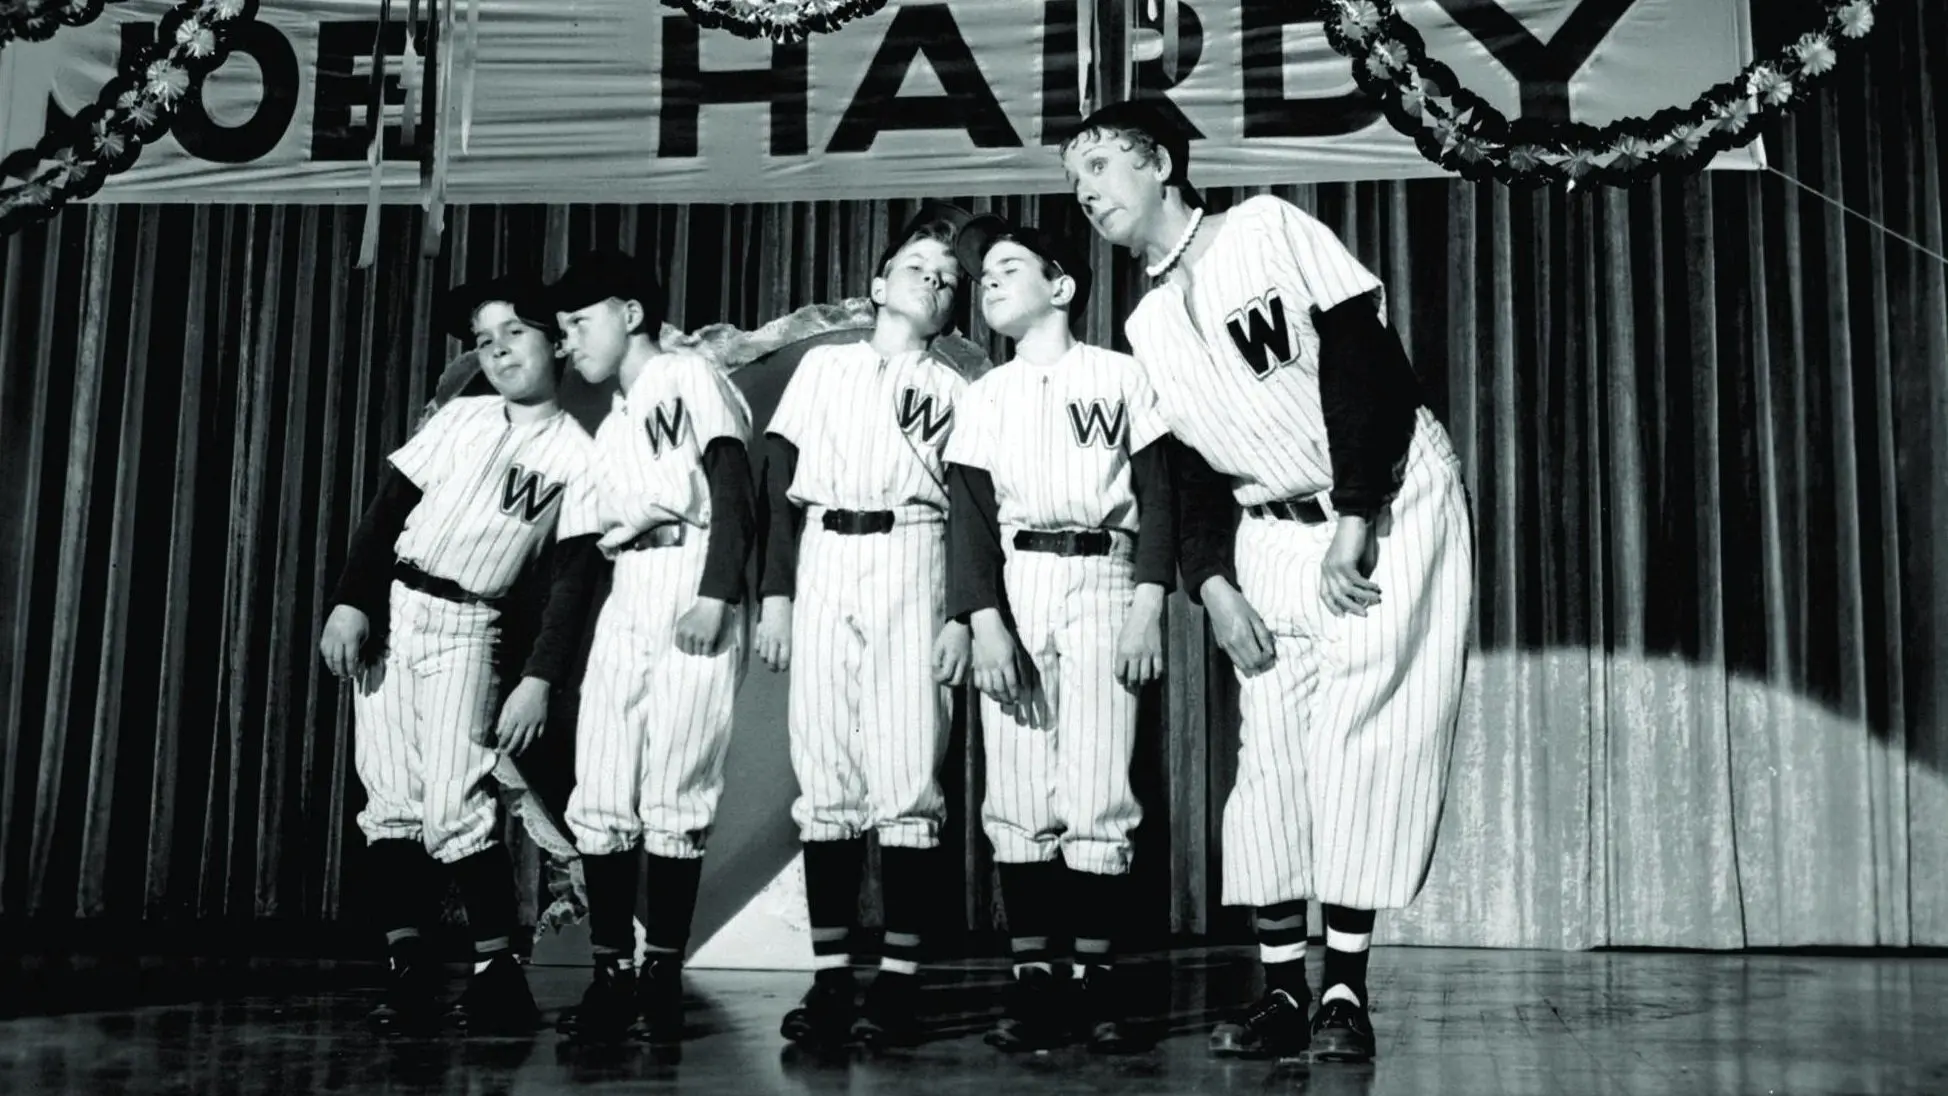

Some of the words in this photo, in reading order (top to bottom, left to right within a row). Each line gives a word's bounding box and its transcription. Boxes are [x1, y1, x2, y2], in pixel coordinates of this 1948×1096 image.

[657, 0, 1636, 158] HARDY
[1226, 287, 1299, 380] W
[644, 396, 686, 459] W
[900, 385, 954, 443] W
[1067, 397, 1129, 449] W
[500, 463, 565, 524] W
